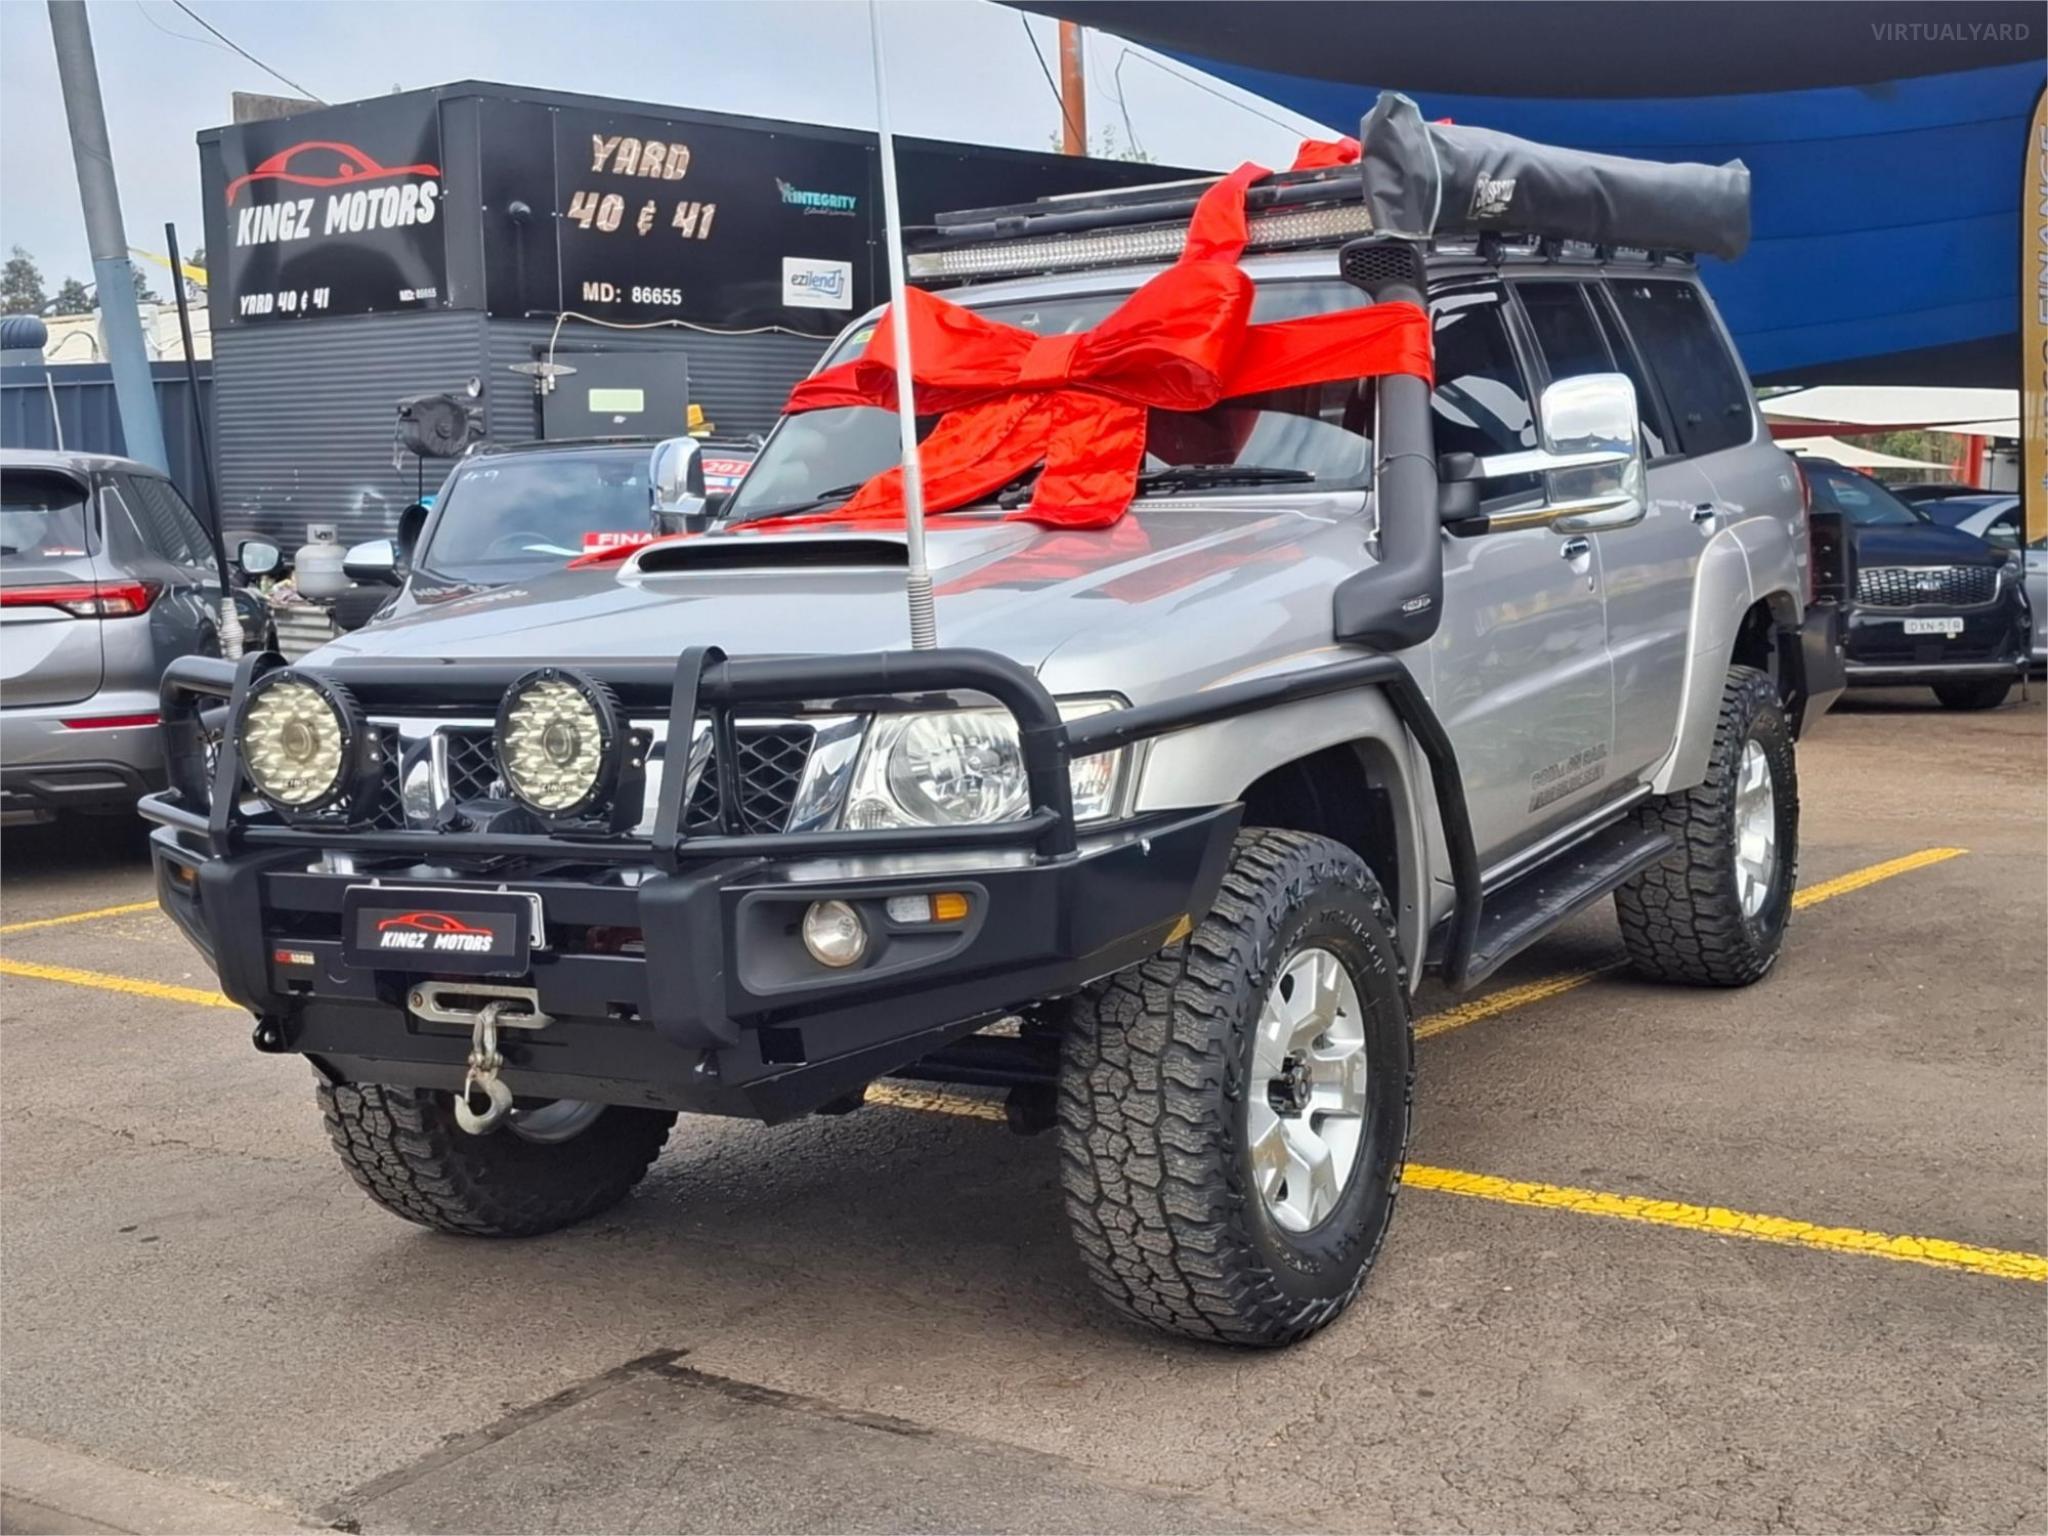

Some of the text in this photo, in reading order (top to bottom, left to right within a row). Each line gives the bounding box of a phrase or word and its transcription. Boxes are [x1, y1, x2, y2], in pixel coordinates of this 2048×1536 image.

[591, 133, 691, 181] YARD
[236, 180, 439, 247] KINGZ MOTORS
[793, 190, 856, 210] INTEGRITY
[567, 191, 716, 240] 40 & 41
[240, 293, 274, 315] YARD
[277, 290, 297, 312] 40
[313, 287, 330, 309] 41
[583, 281, 682, 305] MD: 86655
[380, 931, 494, 952] KINGZ MOTORS
